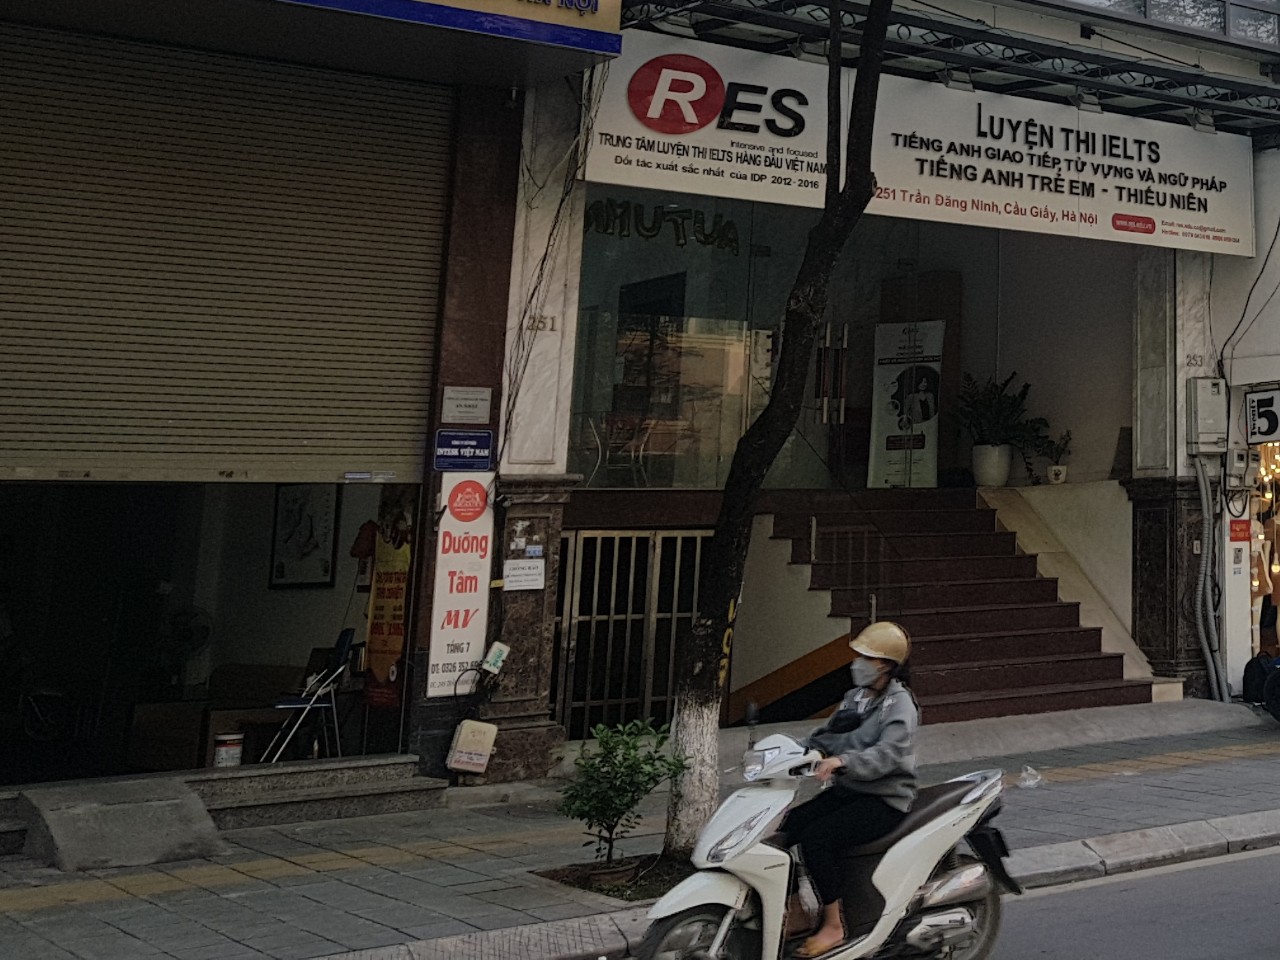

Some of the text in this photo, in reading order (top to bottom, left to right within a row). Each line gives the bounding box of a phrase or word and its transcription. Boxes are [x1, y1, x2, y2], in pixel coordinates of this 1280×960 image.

[599, 133, 632, 149] TRUNG
[635, 136, 655, 152] TÂM
[657, 141, 689, 159] LUYỆN
[692, 146, 707, 159] THI
[709, 148, 733, 162] IELTS
[736, 150, 760, 166] HÀNG
[785, 157, 804, 173] VIỆT
[806, 161, 827, 174] NAM
[1061, 128, 1096, 155] THI
[1103, 134, 1160, 163] IELTS
[891, 131, 942, 152] TIẾNG
[946, 142, 981, 158] ANH
[985, 147, 1024, 164] GIAO
[1137, 167, 1155, 183] VÀ
[1192, 176, 1227, 192] PHÁP
[751, 173, 767, 182] IDP
[916, 155, 977, 182] TIẾNG
[982, 168, 1023, 188] ANH
[1027, 171, 1065, 194] TRẺ
[1069, 179, 1094, 198] EM
[1115, 185, 1167, 207] THIẾU
[1170, 192, 1207, 214] NIÊN
[876, 186, 896, 200] 251
[900, 188, 930, 205] Trần
[935, 193, 967, 212] Đăng
[1004, 201, 1027, 216] Cầu
[1062, 210, 1076, 222] Hà
[1080, 210, 1098, 227] Nội
[1186, 354, 1203, 367] 253
[1257, 395, 1279, 436] 5
[460, 446, 474, 457] VIỆT
[475, 448, 489, 456] NAM
[448, 570, 478, 594] Tâm
[440, 608, 480, 630] MV
[466, 642, 471, 653] 7
